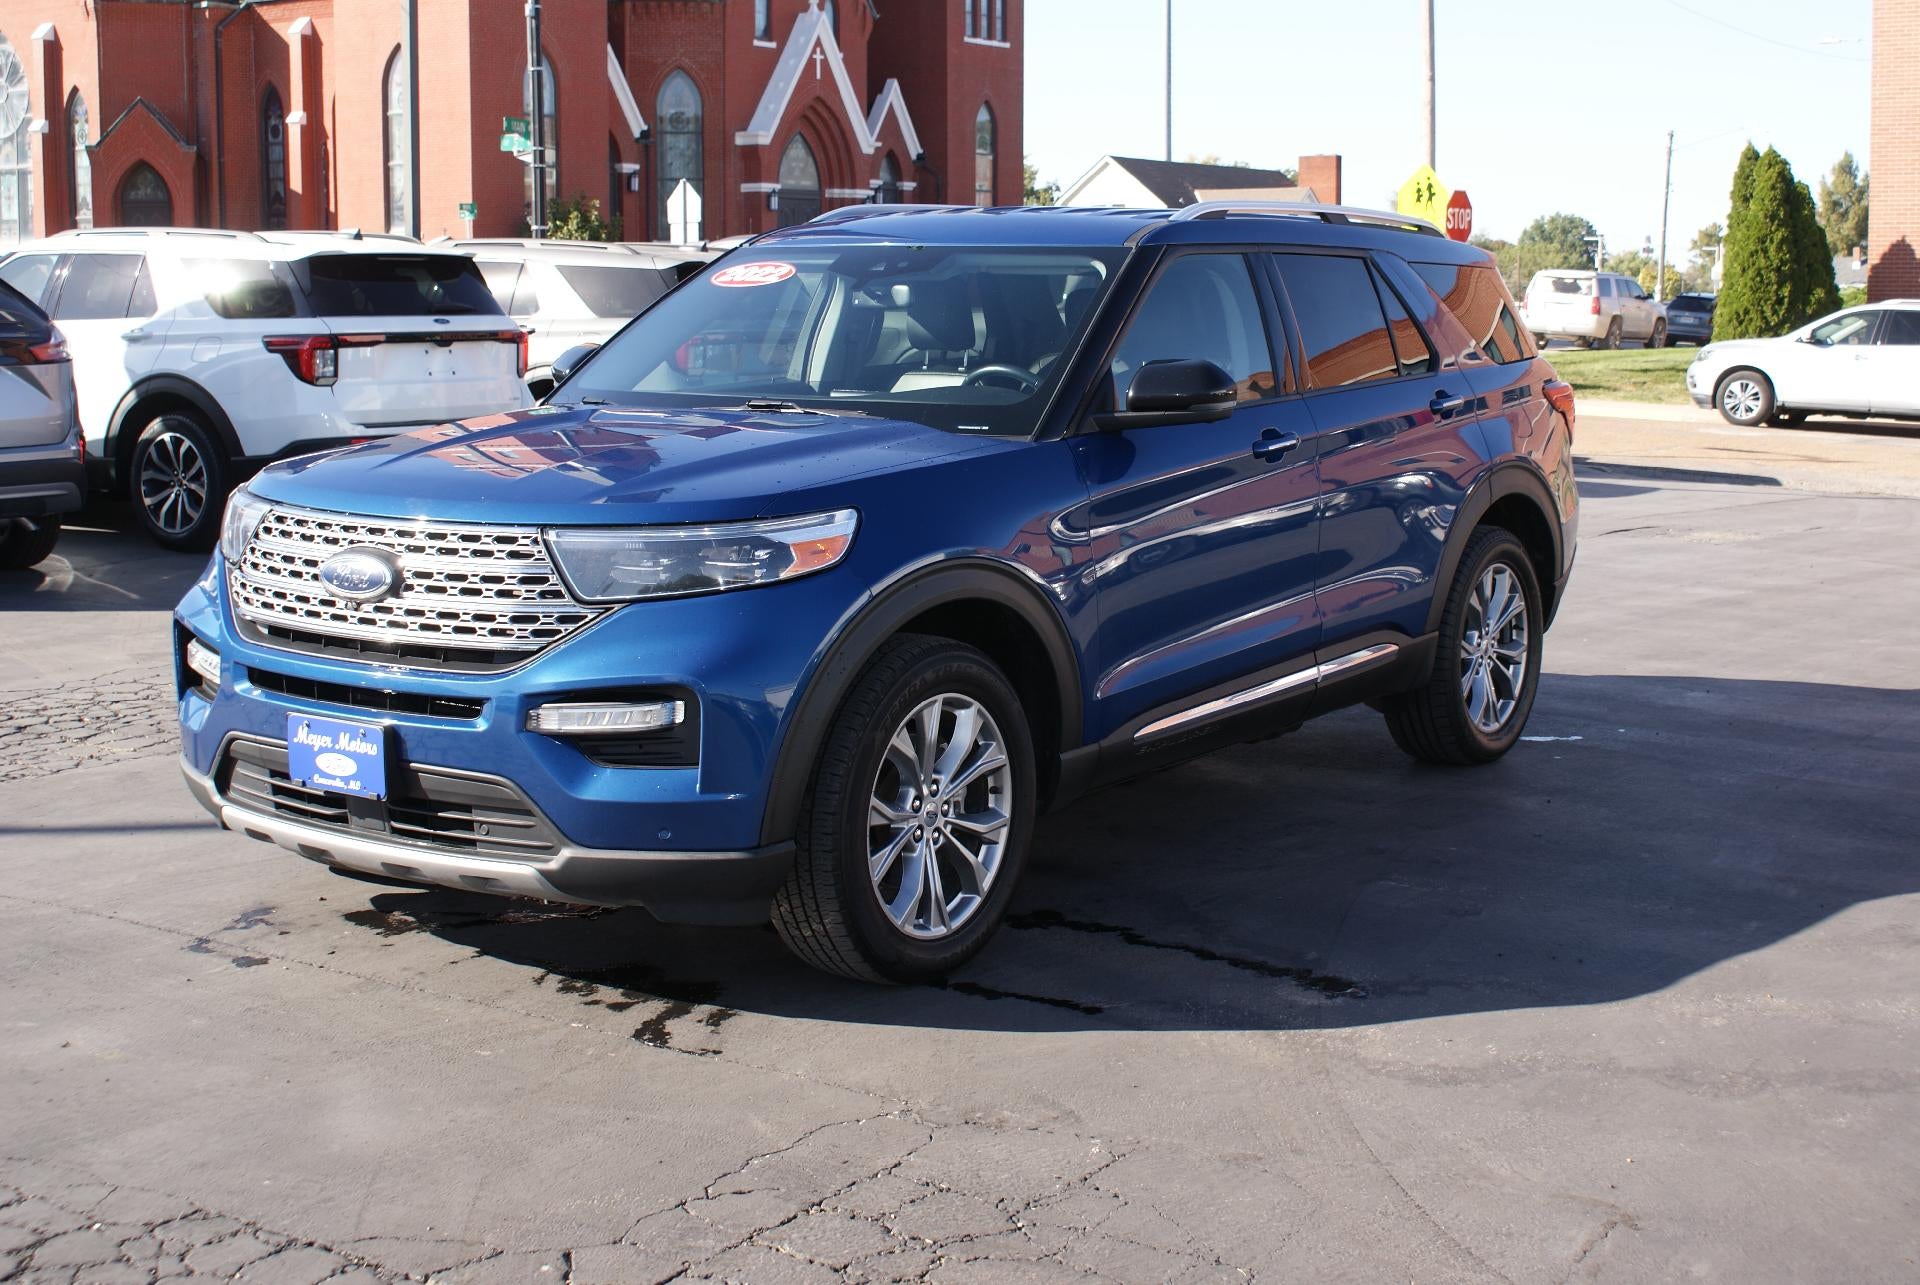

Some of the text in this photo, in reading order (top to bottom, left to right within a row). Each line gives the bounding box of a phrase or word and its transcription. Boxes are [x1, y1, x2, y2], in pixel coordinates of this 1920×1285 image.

[1447, 207, 1471, 230] STOP
[332, 564, 370, 588] Ford
[293, 725, 378, 756] Meyer Motors
